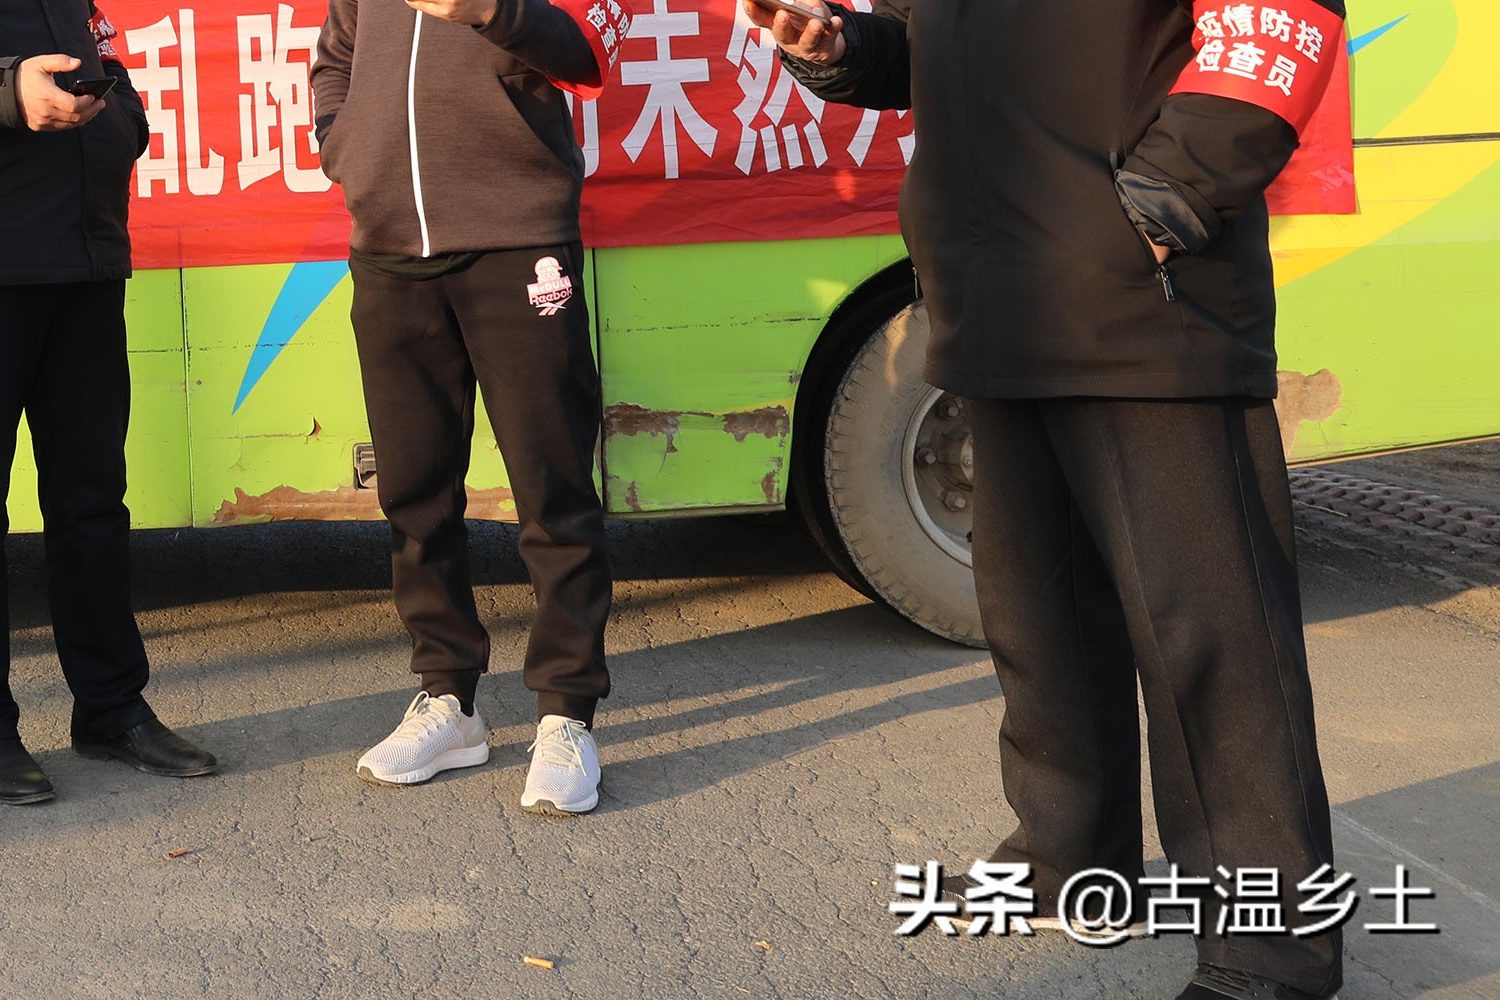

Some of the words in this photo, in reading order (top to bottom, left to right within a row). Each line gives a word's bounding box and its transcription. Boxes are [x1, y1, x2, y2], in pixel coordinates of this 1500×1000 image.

[1196, 3, 1325, 63] 疫情防控
[1195, 40, 1298, 97] 检查员
